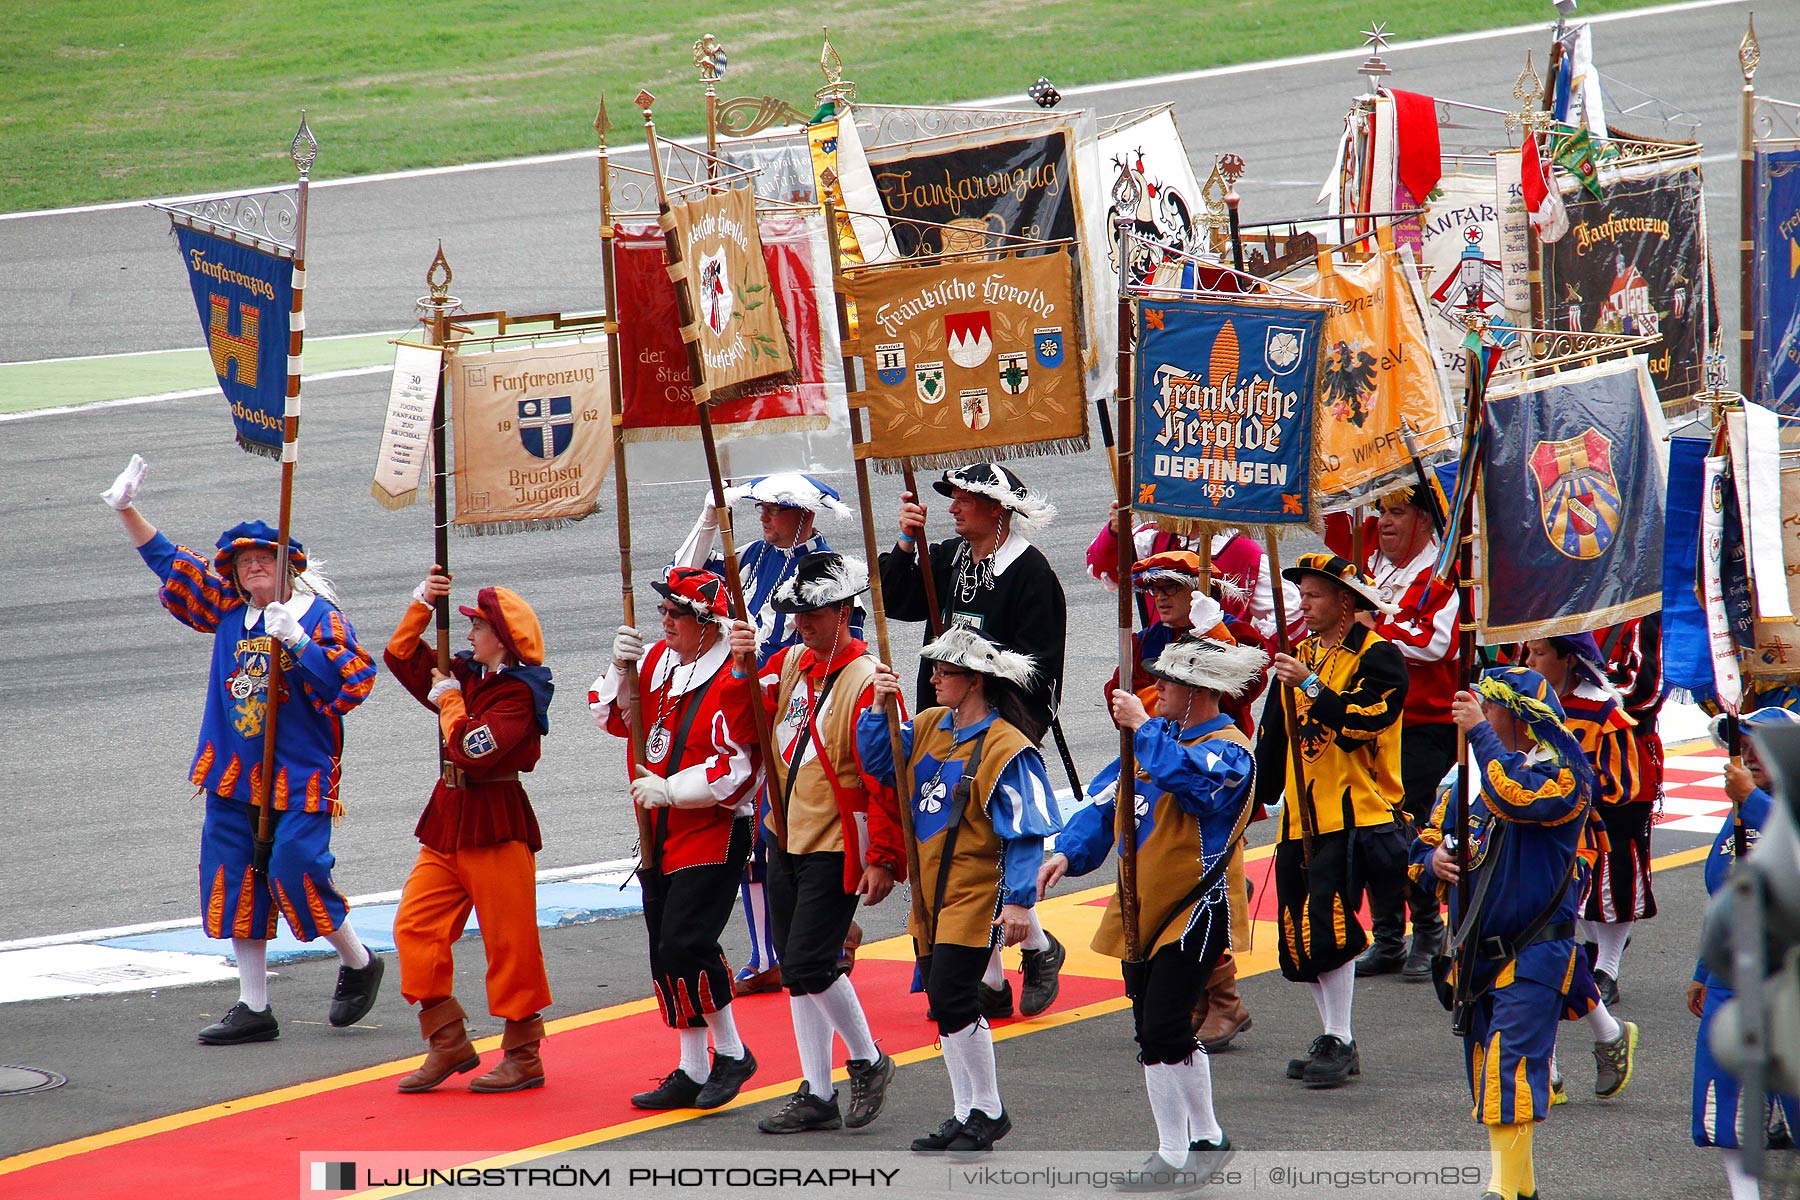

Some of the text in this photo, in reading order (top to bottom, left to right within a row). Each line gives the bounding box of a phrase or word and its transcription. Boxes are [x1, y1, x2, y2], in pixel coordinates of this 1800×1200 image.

[876, 162, 1060, 216] Fanfarenzug
[1021, 225, 1041, 240] 59
[1425, 204, 1498, 242] ANFAR
[1573, 212, 1670, 256] Fanfarenzug
[189, 248, 276, 301] Fanfarenzug
[875, 273, 1055, 338] Fränkische Herolde
[639, 347, 666, 363] der
[883, 353, 898, 368] H
[1381, 343, 1408, 371] e.V.
[410, 375, 421, 385] 30
[493, 367, 595, 394] Fanfarenzug
[655, 366, 691, 382] Stad
[1152, 363, 1298, 421] Fränkische
[497, 409, 598, 432] 19 62
[1154, 410, 1282, 453] Herolde
[1154, 454, 1288, 486] DERTINGEN
[1315, 448, 1341, 473] AD
[509, 464, 583, 486] Bruchsal
[515, 482, 581, 503] Jugend
[1201, 484, 1236, 499] 1956
